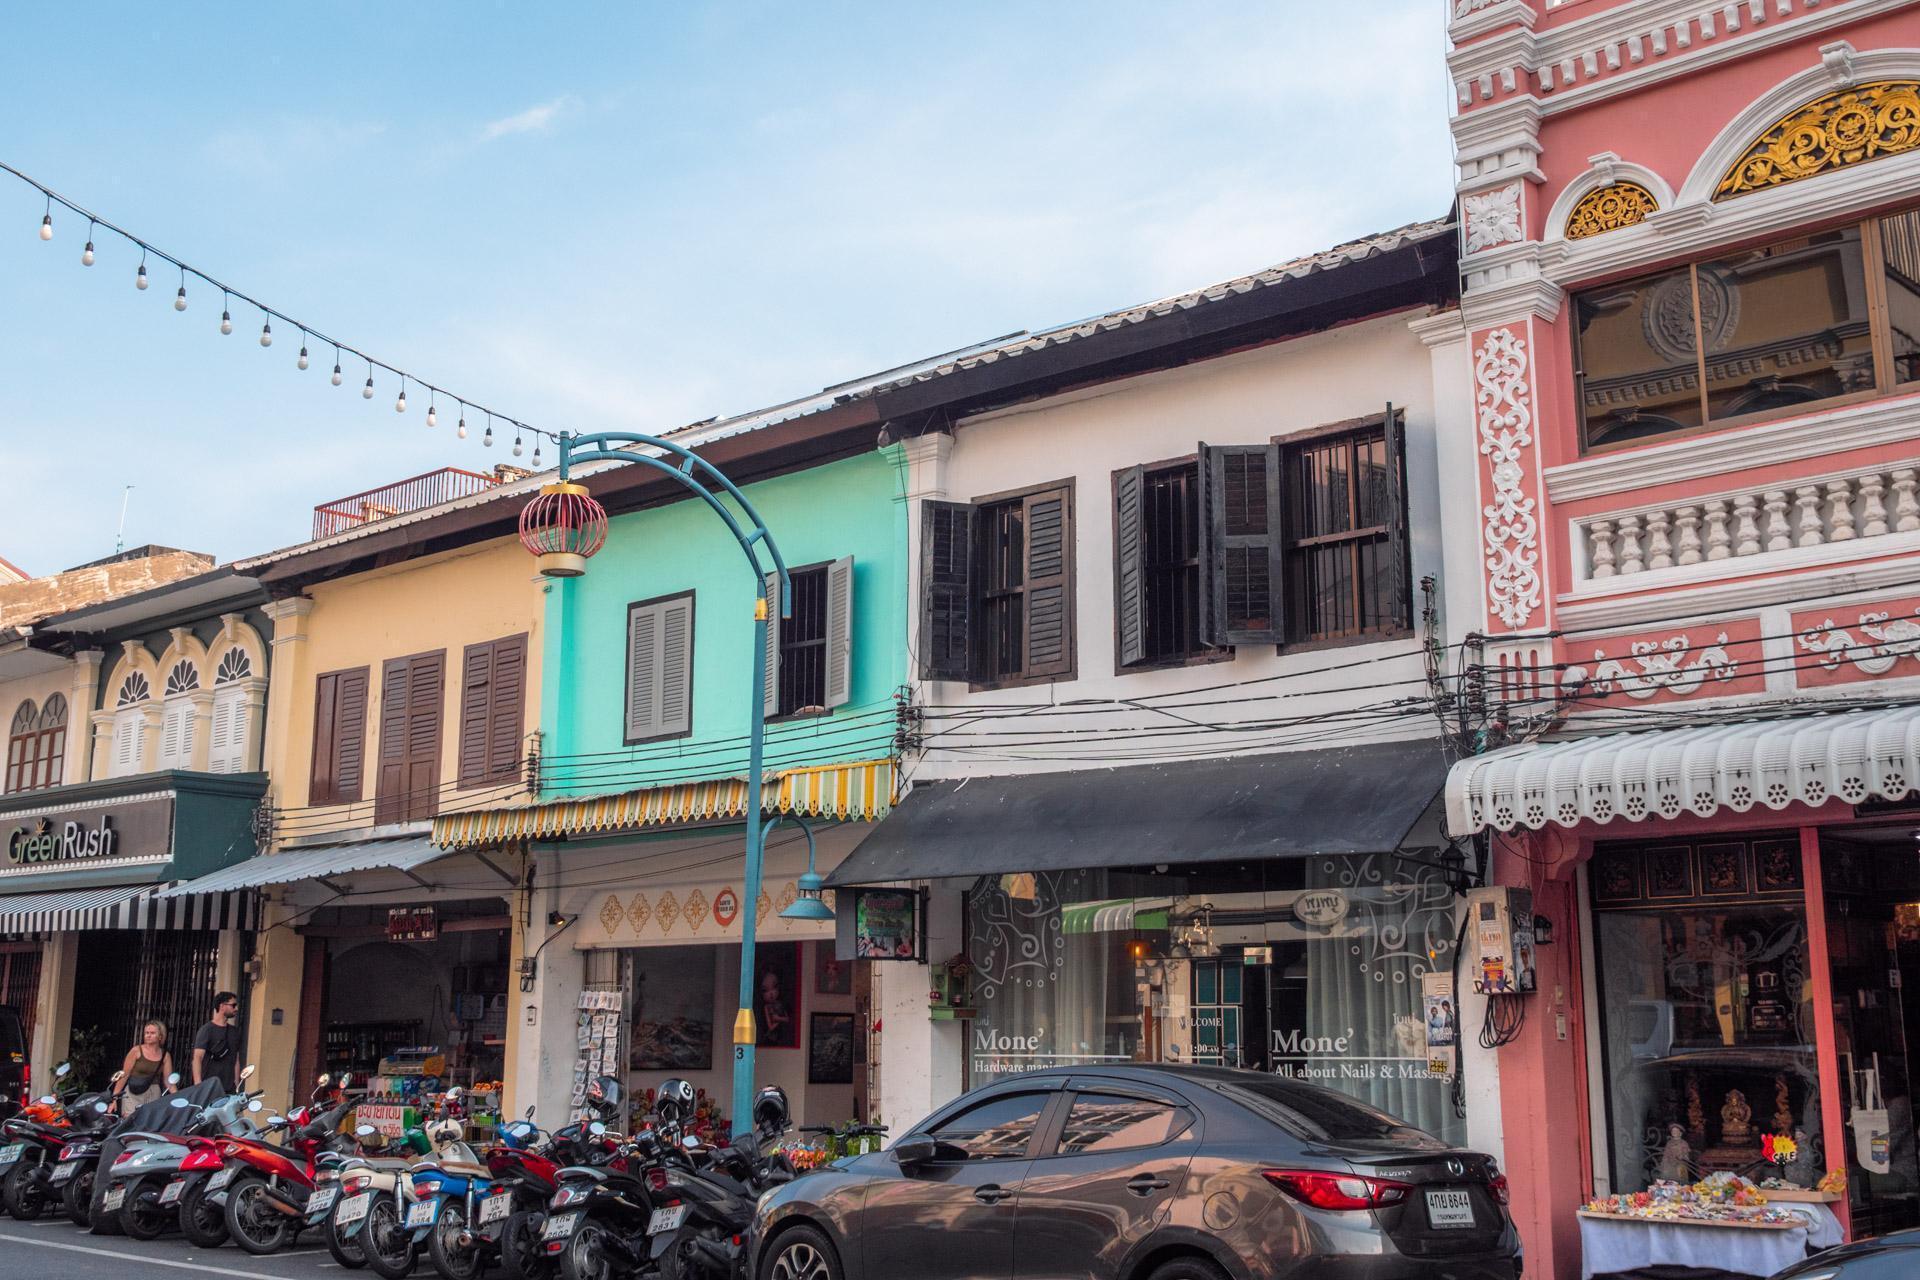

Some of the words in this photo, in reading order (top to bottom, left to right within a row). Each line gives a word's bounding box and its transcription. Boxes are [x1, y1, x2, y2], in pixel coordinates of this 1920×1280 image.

[8, 814, 112, 864] GreenRush
[736, 1047, 744, 1059] 3
[974, 1060, 1023, 1073] Hardware
[1274, 1063, 1293, 1078] All
[1297, 1064, 1336, 1079] about
[1340, 1064, 1375, 1079] Nails
[1380, 1065, 1393, 1079] &
[1448, 1193, 1469, 1209] 8644
